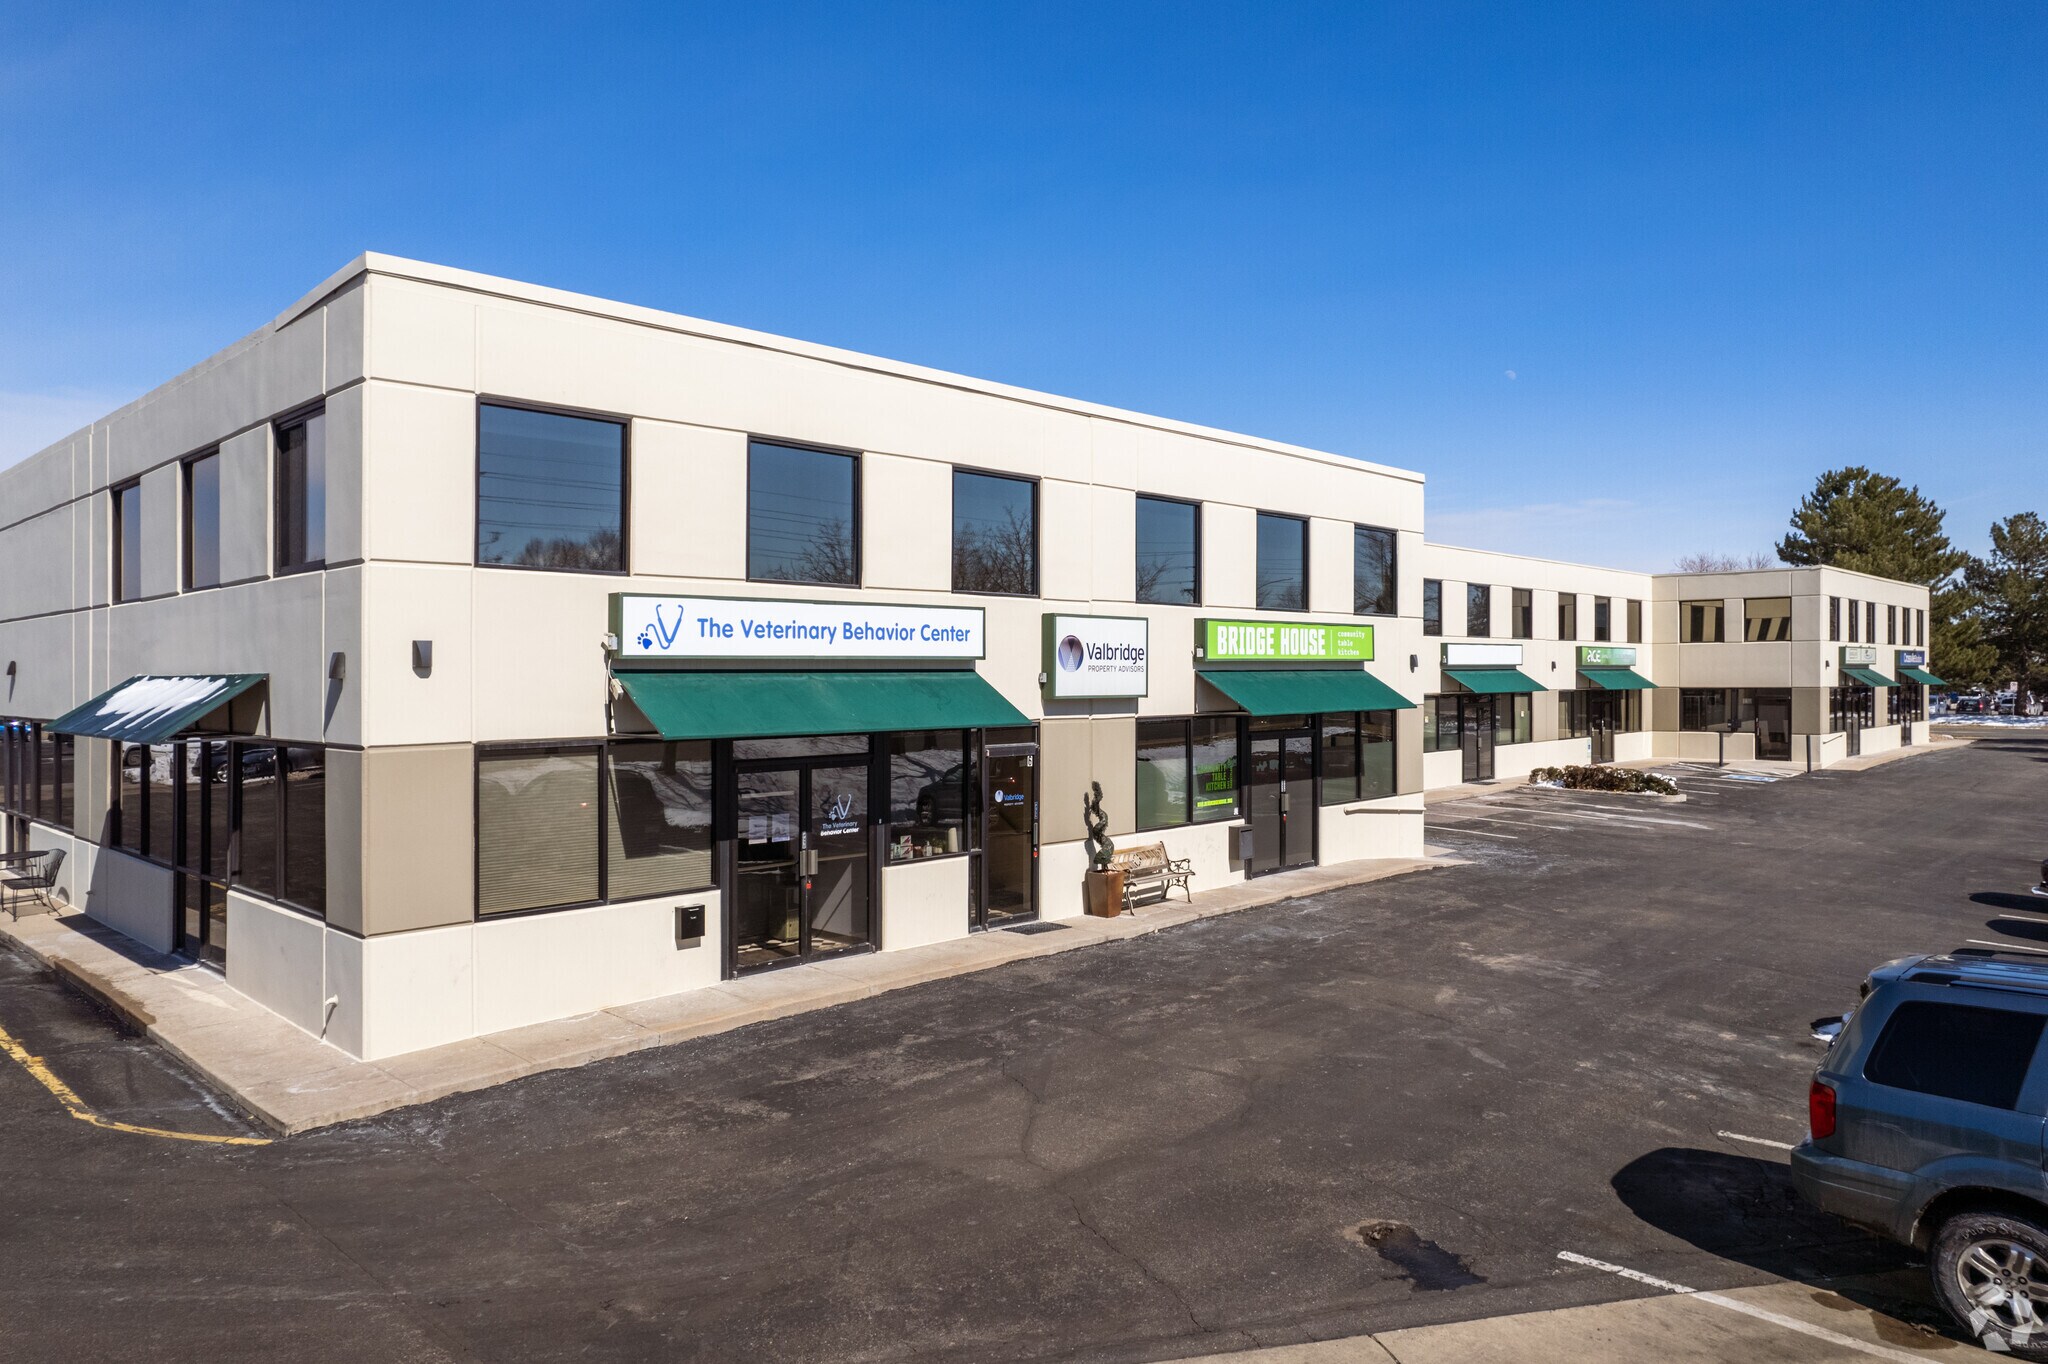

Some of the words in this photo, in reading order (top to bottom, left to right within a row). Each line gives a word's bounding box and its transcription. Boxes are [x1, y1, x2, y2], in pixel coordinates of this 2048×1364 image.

[697, 617, 734, 639] The
[740, 619, 837, 645] Veterinary
[843, 622, 916, 642] Behavior
[921, 624, 971, 642] Center
[1337, 630, 1366, 640] community
[1217, 625, 1275, 656] BRIDGE
[1280, 627, 1326, 656] HOUSE
[1086, 642, 1145, 665] Valbridge
[1337, 648, 1360, 656] kitchen
[1087, 665, 1117, 673] PROPERTY
[1118, 665, 1145, 673] ADVISORS
